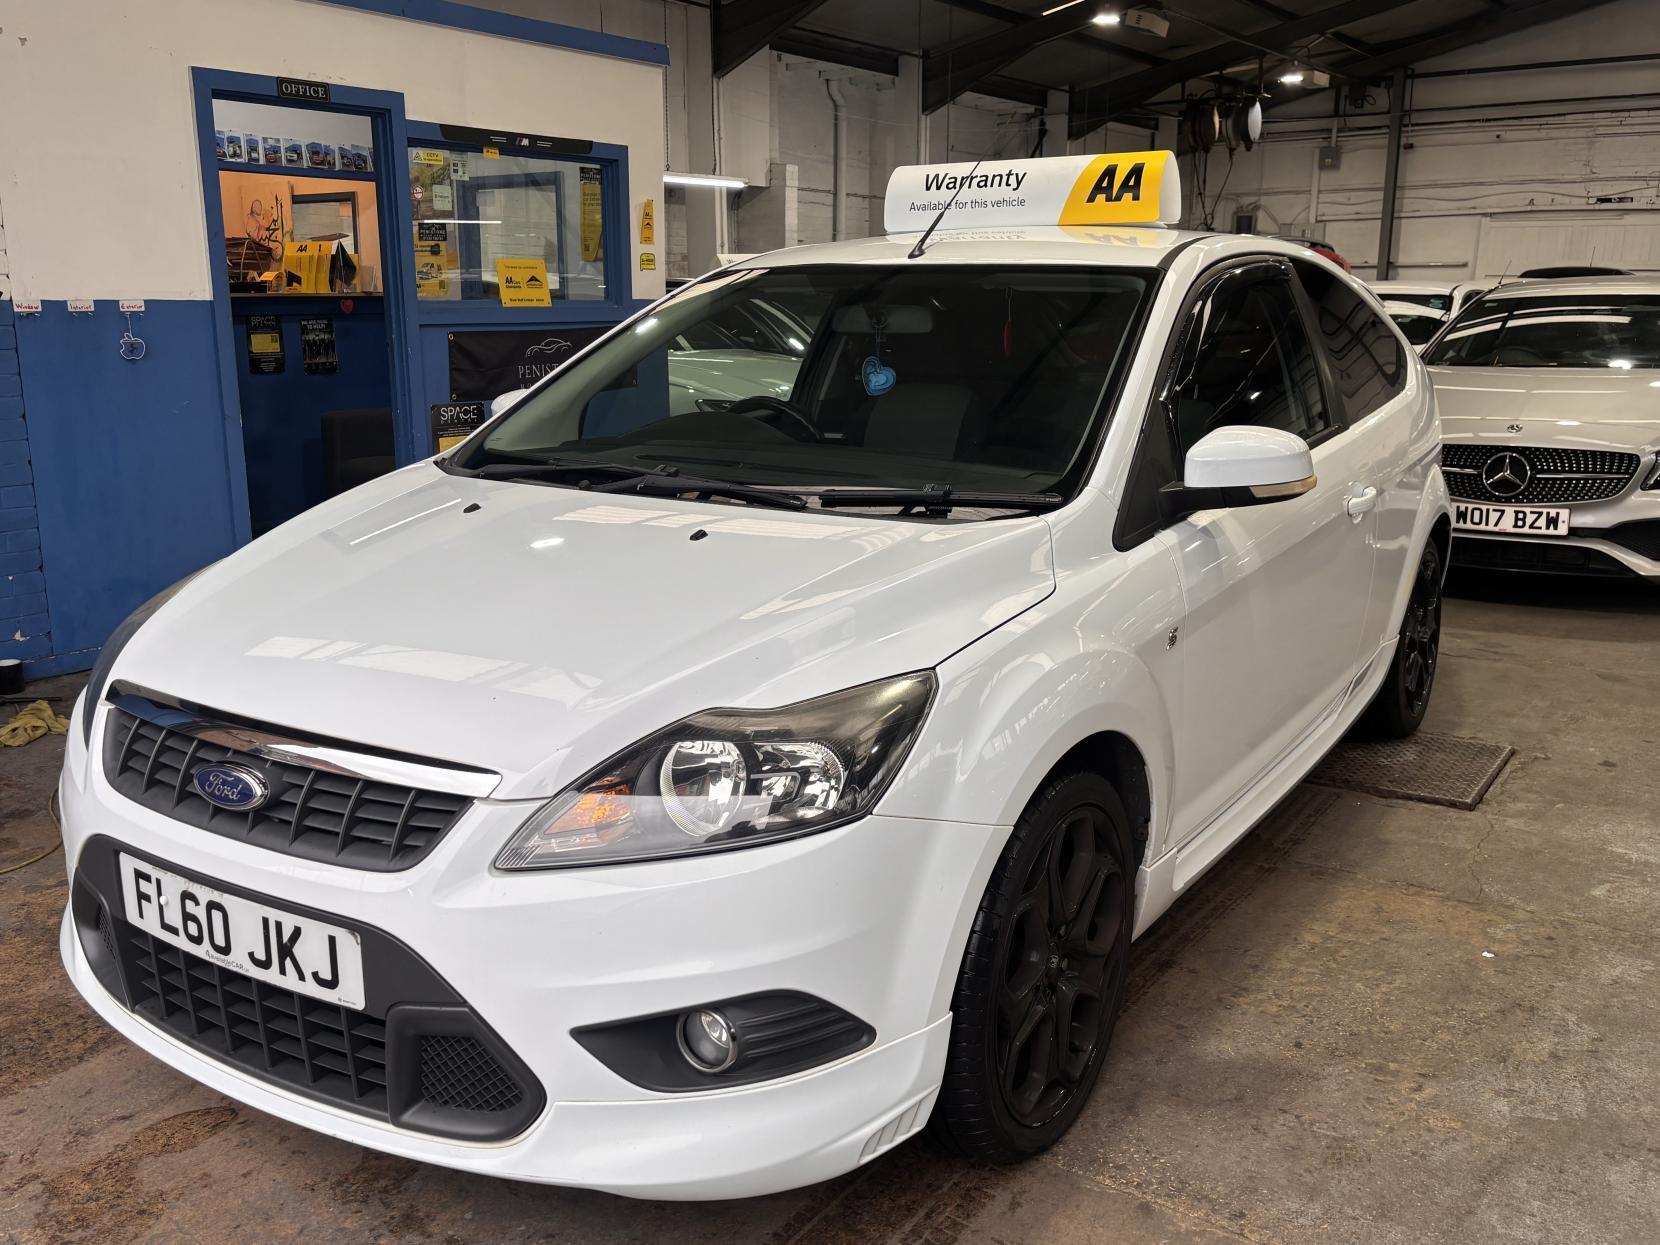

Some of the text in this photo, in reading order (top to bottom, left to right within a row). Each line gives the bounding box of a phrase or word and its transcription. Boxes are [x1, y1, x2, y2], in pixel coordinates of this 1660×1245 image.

[282, 82, 326, 98] OFFICE
[924, 169, 1027, 192] Warranty
[1085, 162, 1146, 204] AA
[909, 196, 1026, 212] Available for this vehicle
[15, 303, 40, 311] Window
[440, 405, 478, 421] SPACE
[1455, 505, 1561, 531] WO17 BZW
[204, 770, 241, 802] Ford
[133, 866, 340, 991] FL60 JKJ
